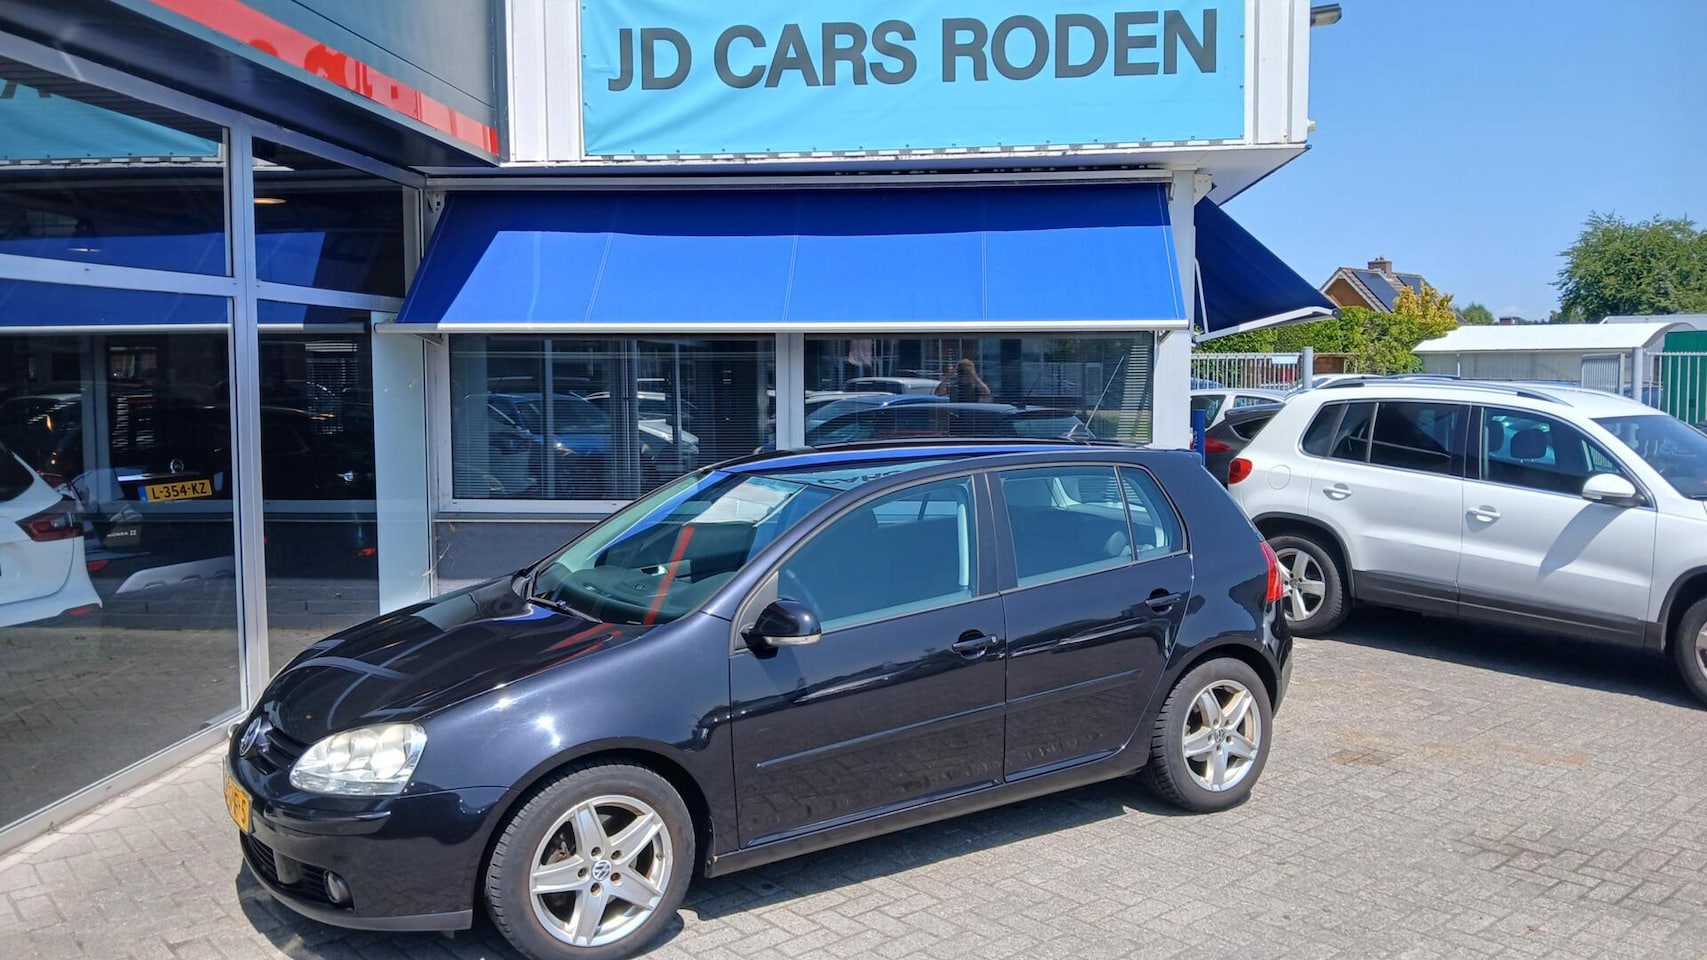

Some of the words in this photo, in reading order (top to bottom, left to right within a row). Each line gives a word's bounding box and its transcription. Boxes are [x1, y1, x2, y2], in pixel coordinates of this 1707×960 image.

[608, 27, 692, 92] JD
[714, 20, 918, 88] CARS
[942, 8, 1217, 83] RODEN
[151, 481, 207, 500] L-354-KZ
